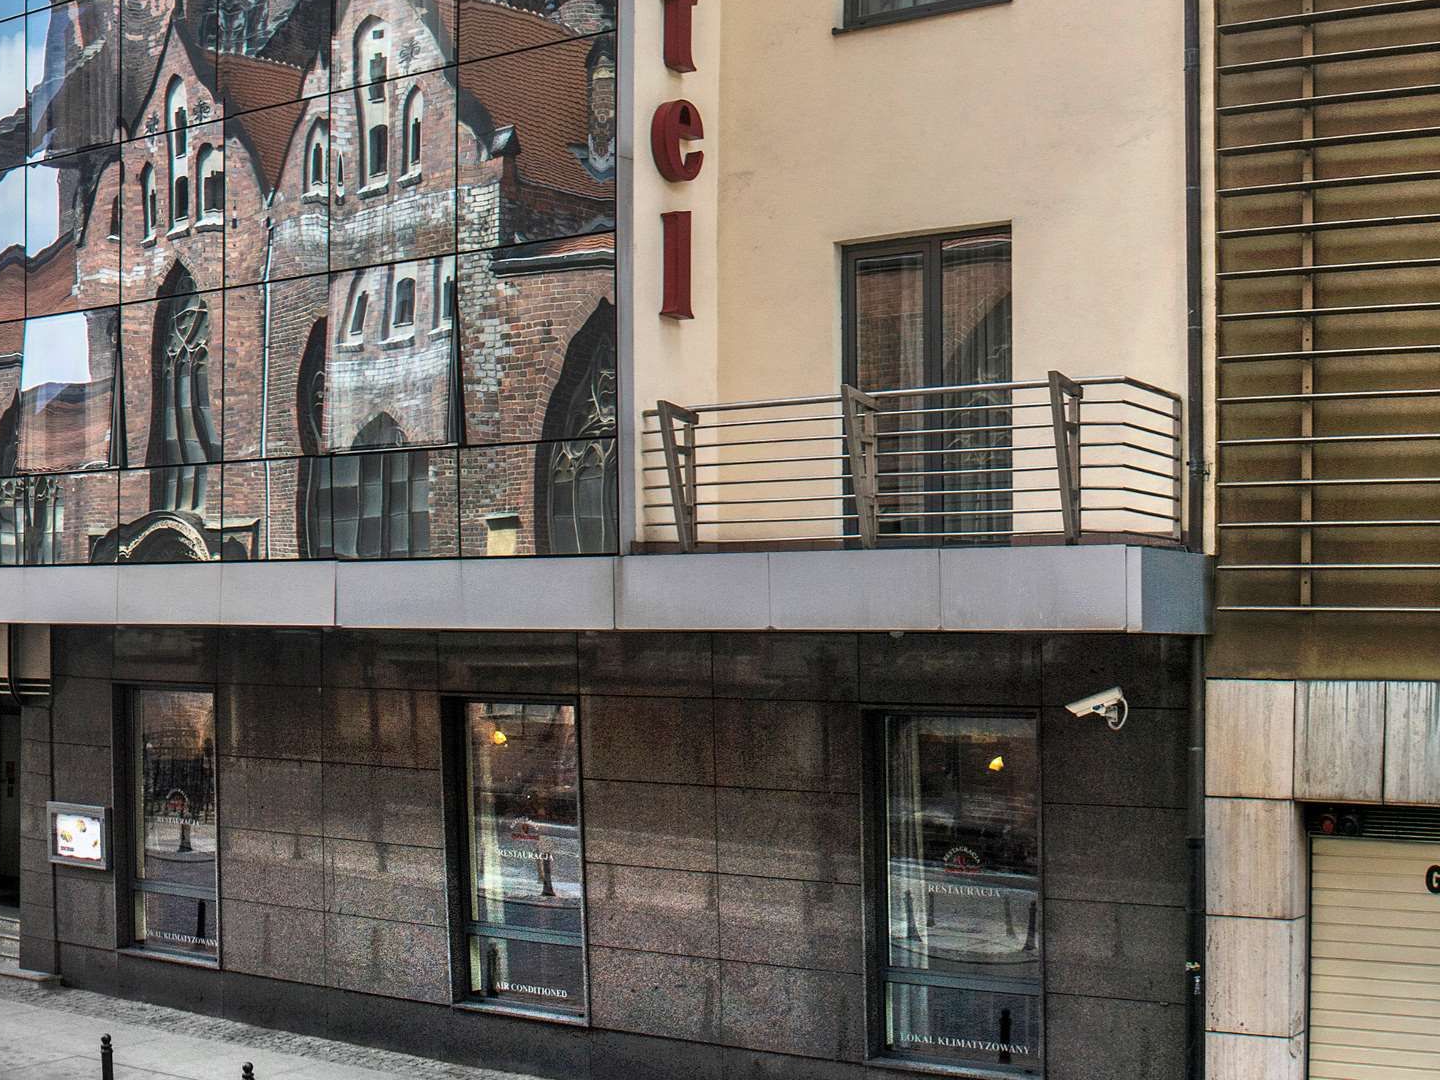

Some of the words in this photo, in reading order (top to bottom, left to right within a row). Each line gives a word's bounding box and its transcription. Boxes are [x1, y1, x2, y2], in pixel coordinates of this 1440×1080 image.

[928, 884, 1000, 897] RESTAURACJA
[496, 981, 510, 991] AIR
[510, 983, 568, 998] CONDITIONED
[900, 1031, 935, 1045] LOKAL
[938, 1036, 1030, 1055] KLIMATYZOWANY
